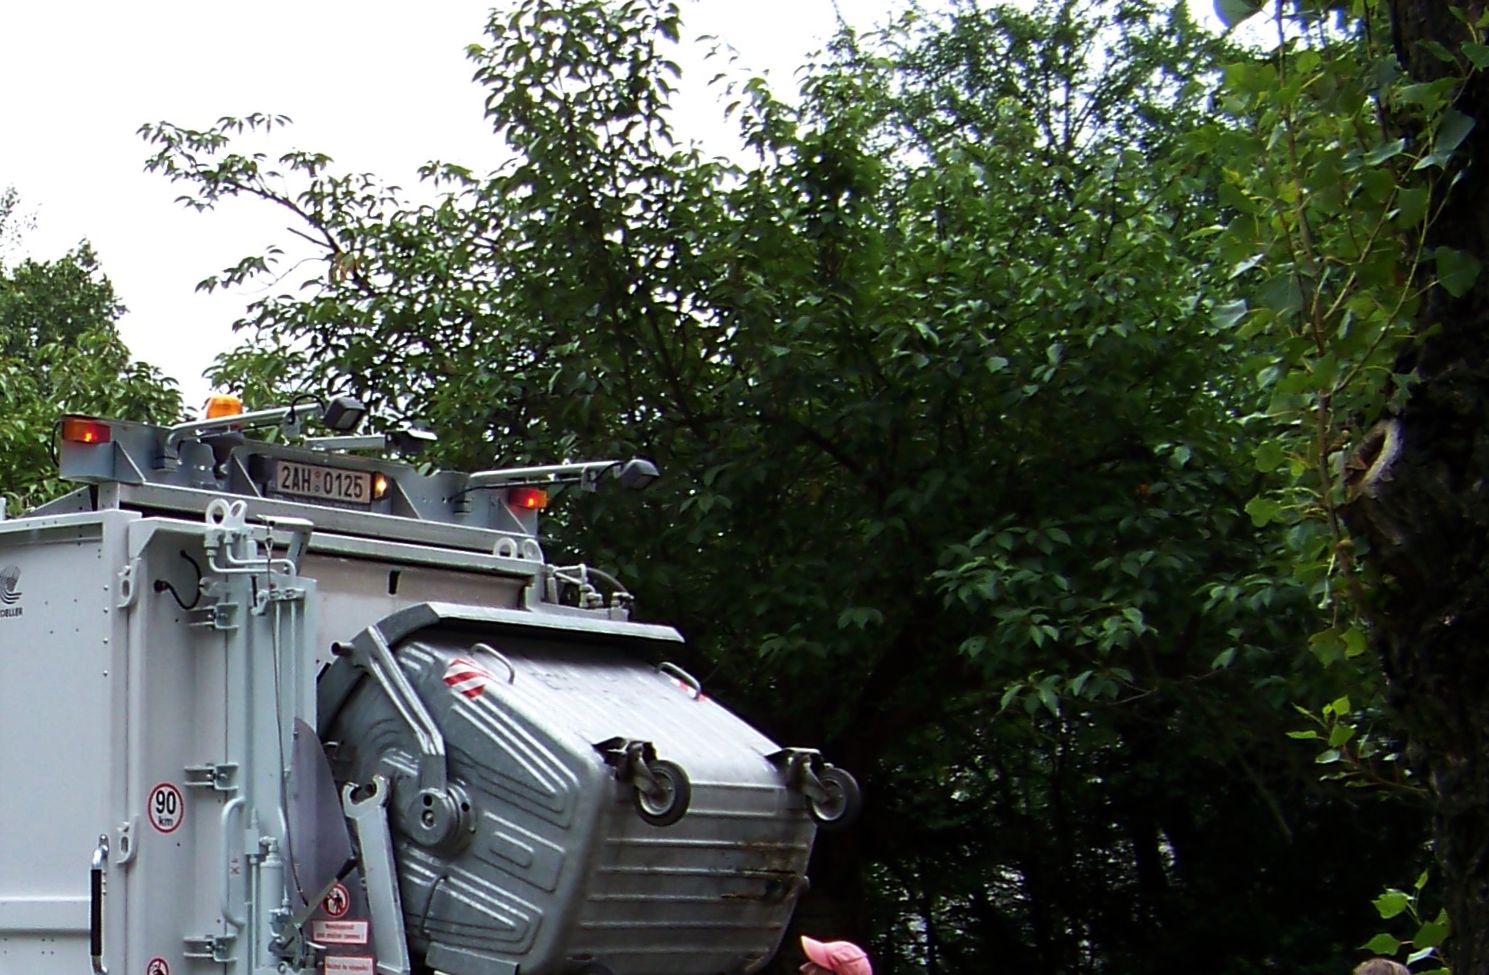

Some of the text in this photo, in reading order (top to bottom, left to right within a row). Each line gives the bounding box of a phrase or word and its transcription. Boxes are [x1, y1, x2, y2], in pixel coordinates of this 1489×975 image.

[281, 465, 363, 498] 2AH 0125
[155, 790, 176, 815] 90
